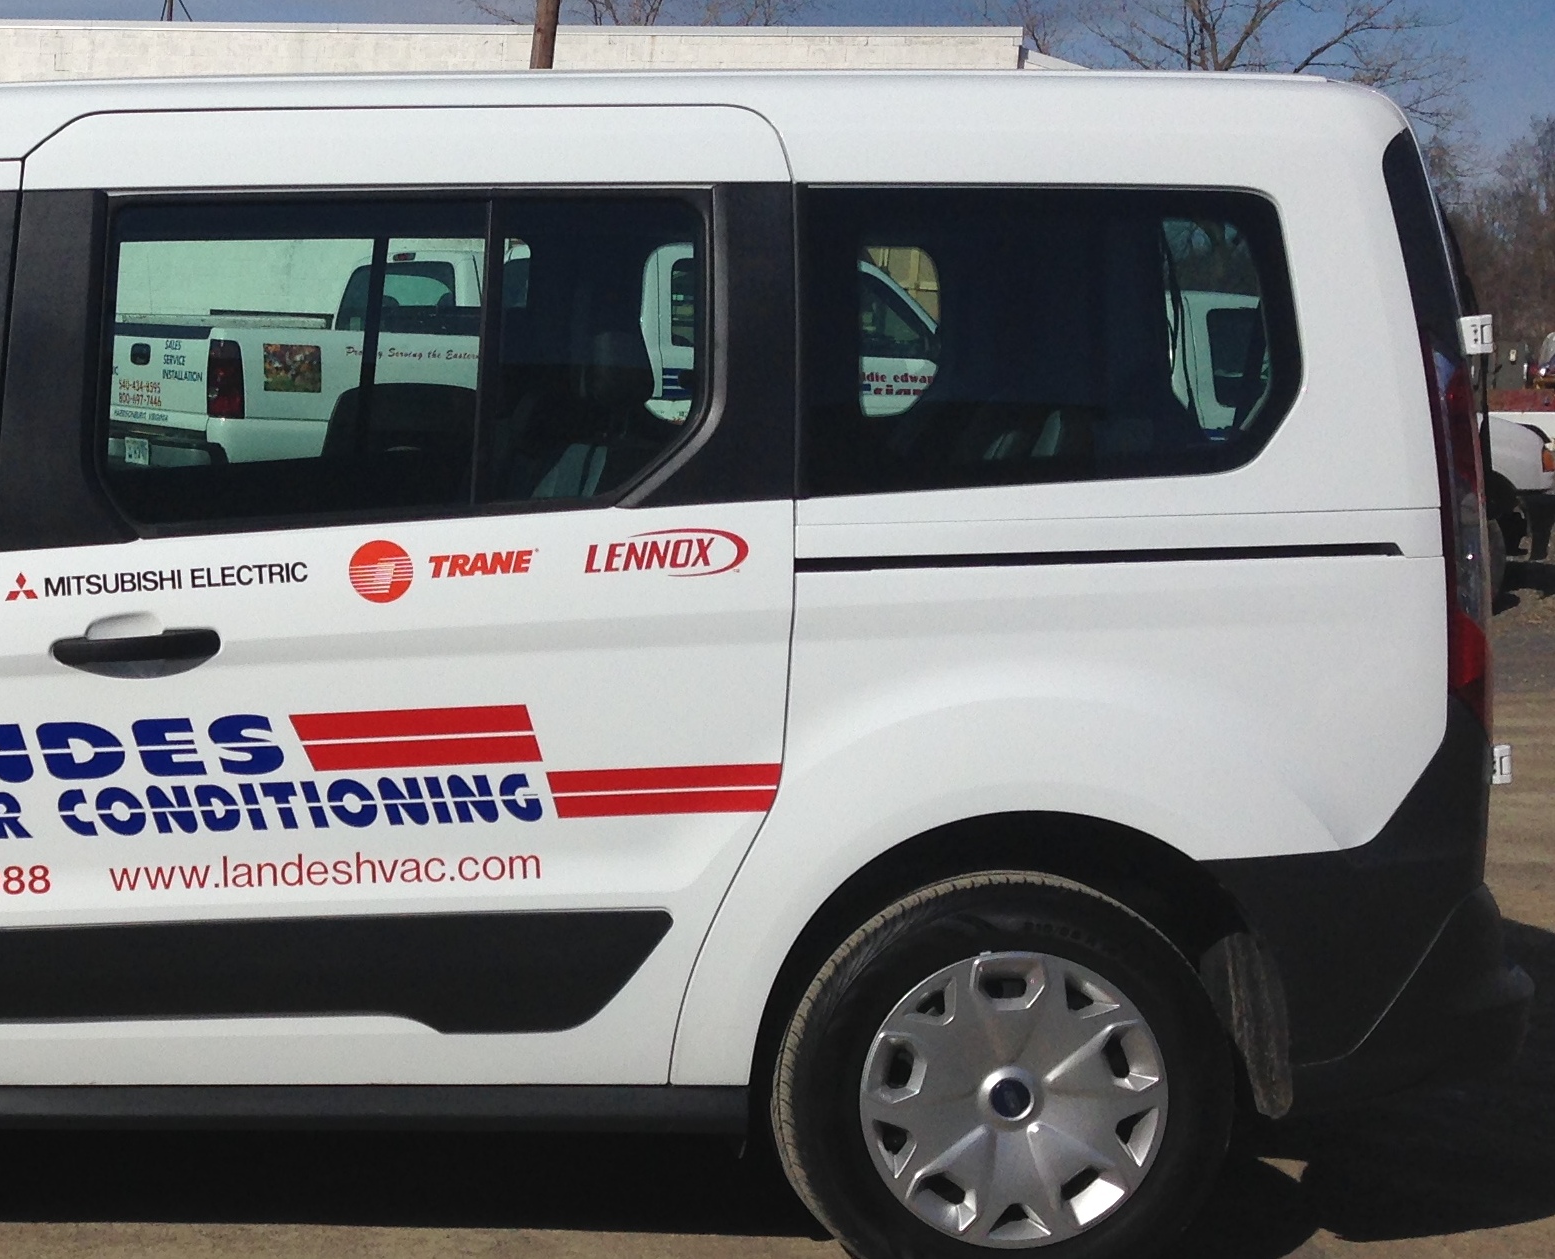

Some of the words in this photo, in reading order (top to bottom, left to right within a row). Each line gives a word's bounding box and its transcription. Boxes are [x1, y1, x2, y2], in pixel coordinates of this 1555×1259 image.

[346, 346, 383, 359] Proy
[388, 347, 423, 361] Serving
[427, 349, 441, 359] the
[428, 549, 533, 579] TRANE
[584, 537, 715, 574] LENNOX
[44, 569, 183, 598] MITSUBISHI
[190, 561, 308, 589] ELECTRIC
[57, 773, 544, 837] CONDITIONING
[109, 851, 541, 892] www.landeshvac.com
